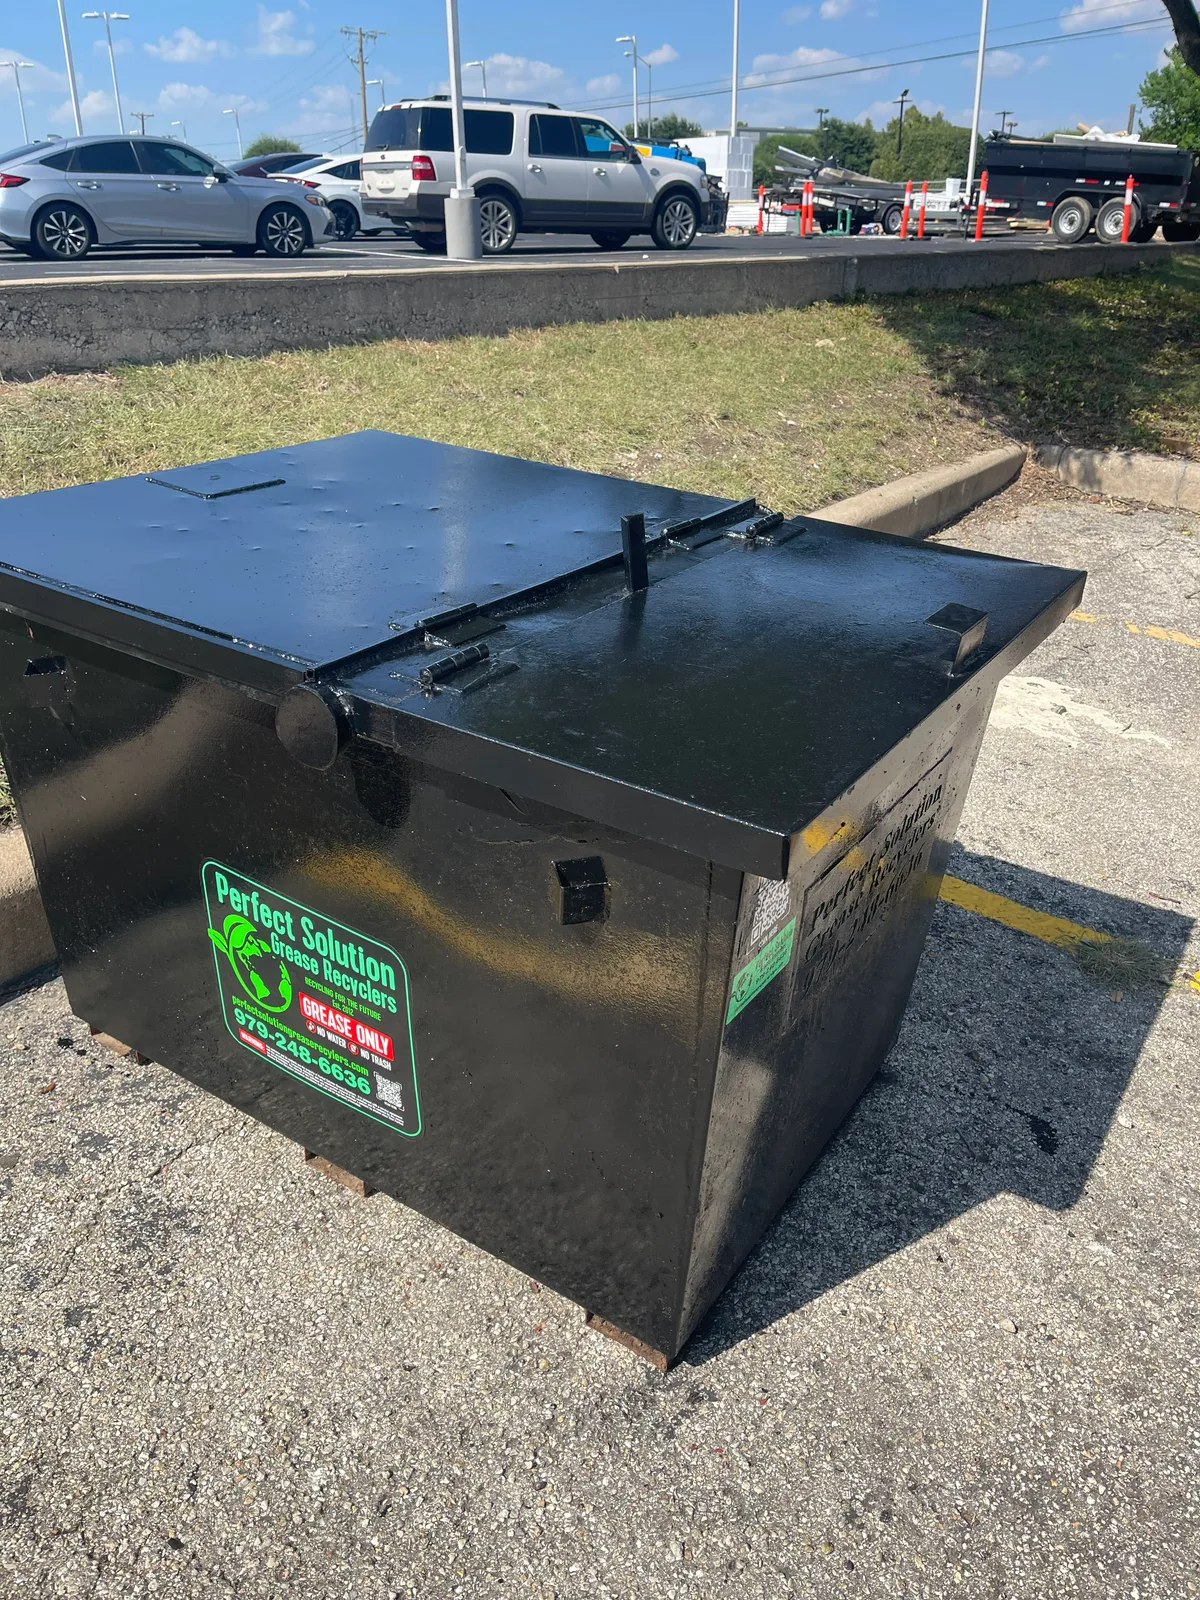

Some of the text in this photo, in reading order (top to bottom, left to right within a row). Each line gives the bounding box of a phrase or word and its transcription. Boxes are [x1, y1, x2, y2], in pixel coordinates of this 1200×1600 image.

[805, 813, 937, 964] Grease Recyclers
[808, 785, 943, 937] Perfect Solution
[215, 871, 395, 990] Perfect Solution
[270, 931, 397, 1013] Grease Recyclers
[305, 976, 381, 1021] RECYCLING FOR THE FUTURE
[342, 1004, 354, 1016] 2012
[233, 1007, 371, 1095] 979-248-6636
[302, 996, 389, 1055] GREASE ONLY
[316, 1025, 392, 1071] NO WATER NO TRASH
